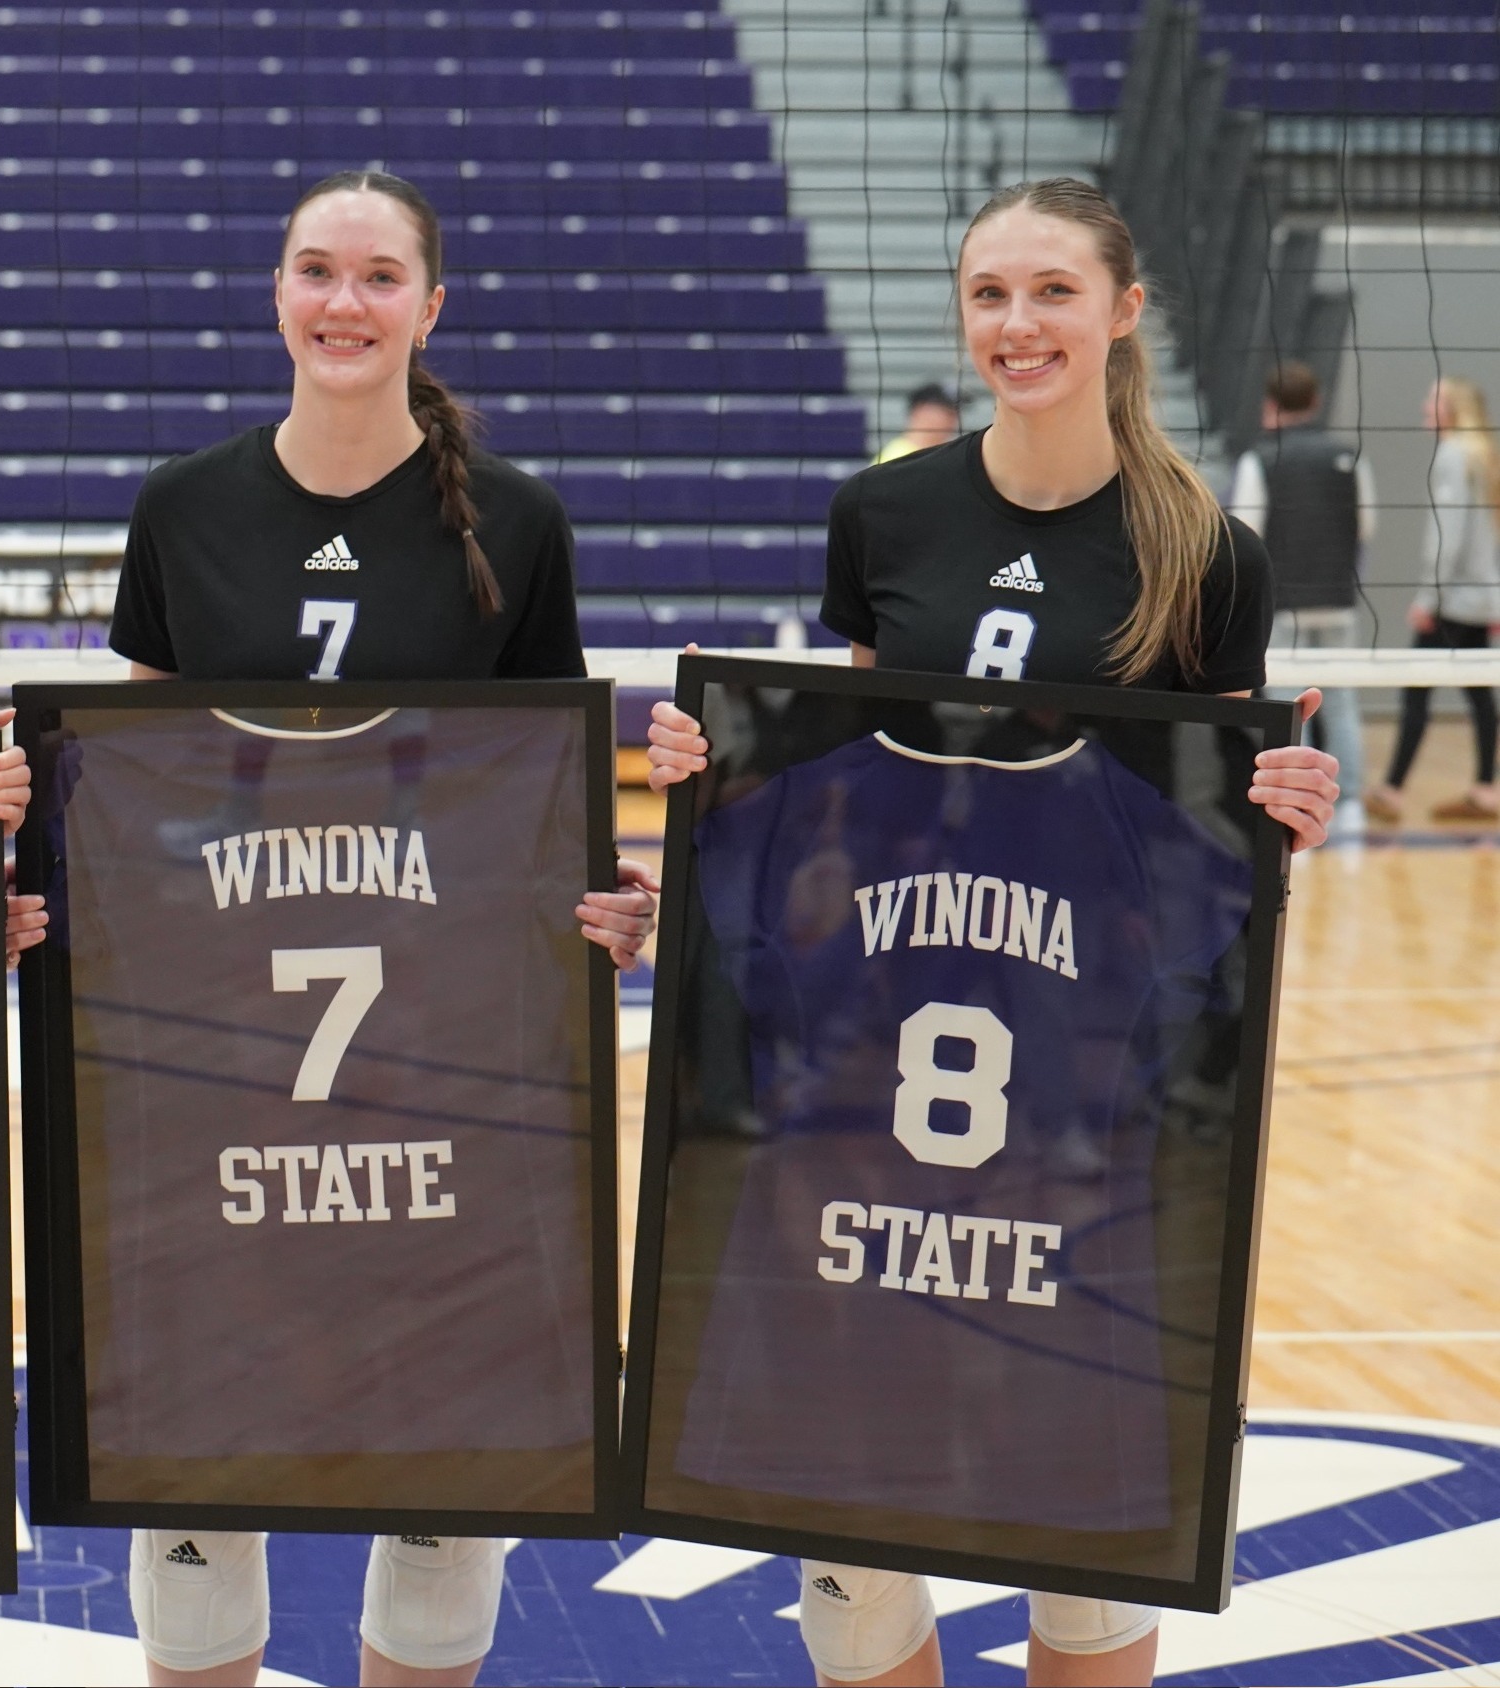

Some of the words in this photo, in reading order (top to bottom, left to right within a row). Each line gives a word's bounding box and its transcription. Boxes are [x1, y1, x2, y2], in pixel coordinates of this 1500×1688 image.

[304, 557, 359, 571] adidas
[989, 574, 1044, 593] adidas
[297, 598, 358, 683] 7
[965, 606, 1038, 681] 8
[202, 826, 436, 909] WINONA
[855, 873, 1078, 979] WINONA
[272, 946, 383, 1100] 7
[893, 1002, 1013, 1168] 8
[219, 1140, 455, 1223] STATE
[818, 1201, 1062, 1306] STATE
[166, 1553, 207, 1565] adidas
